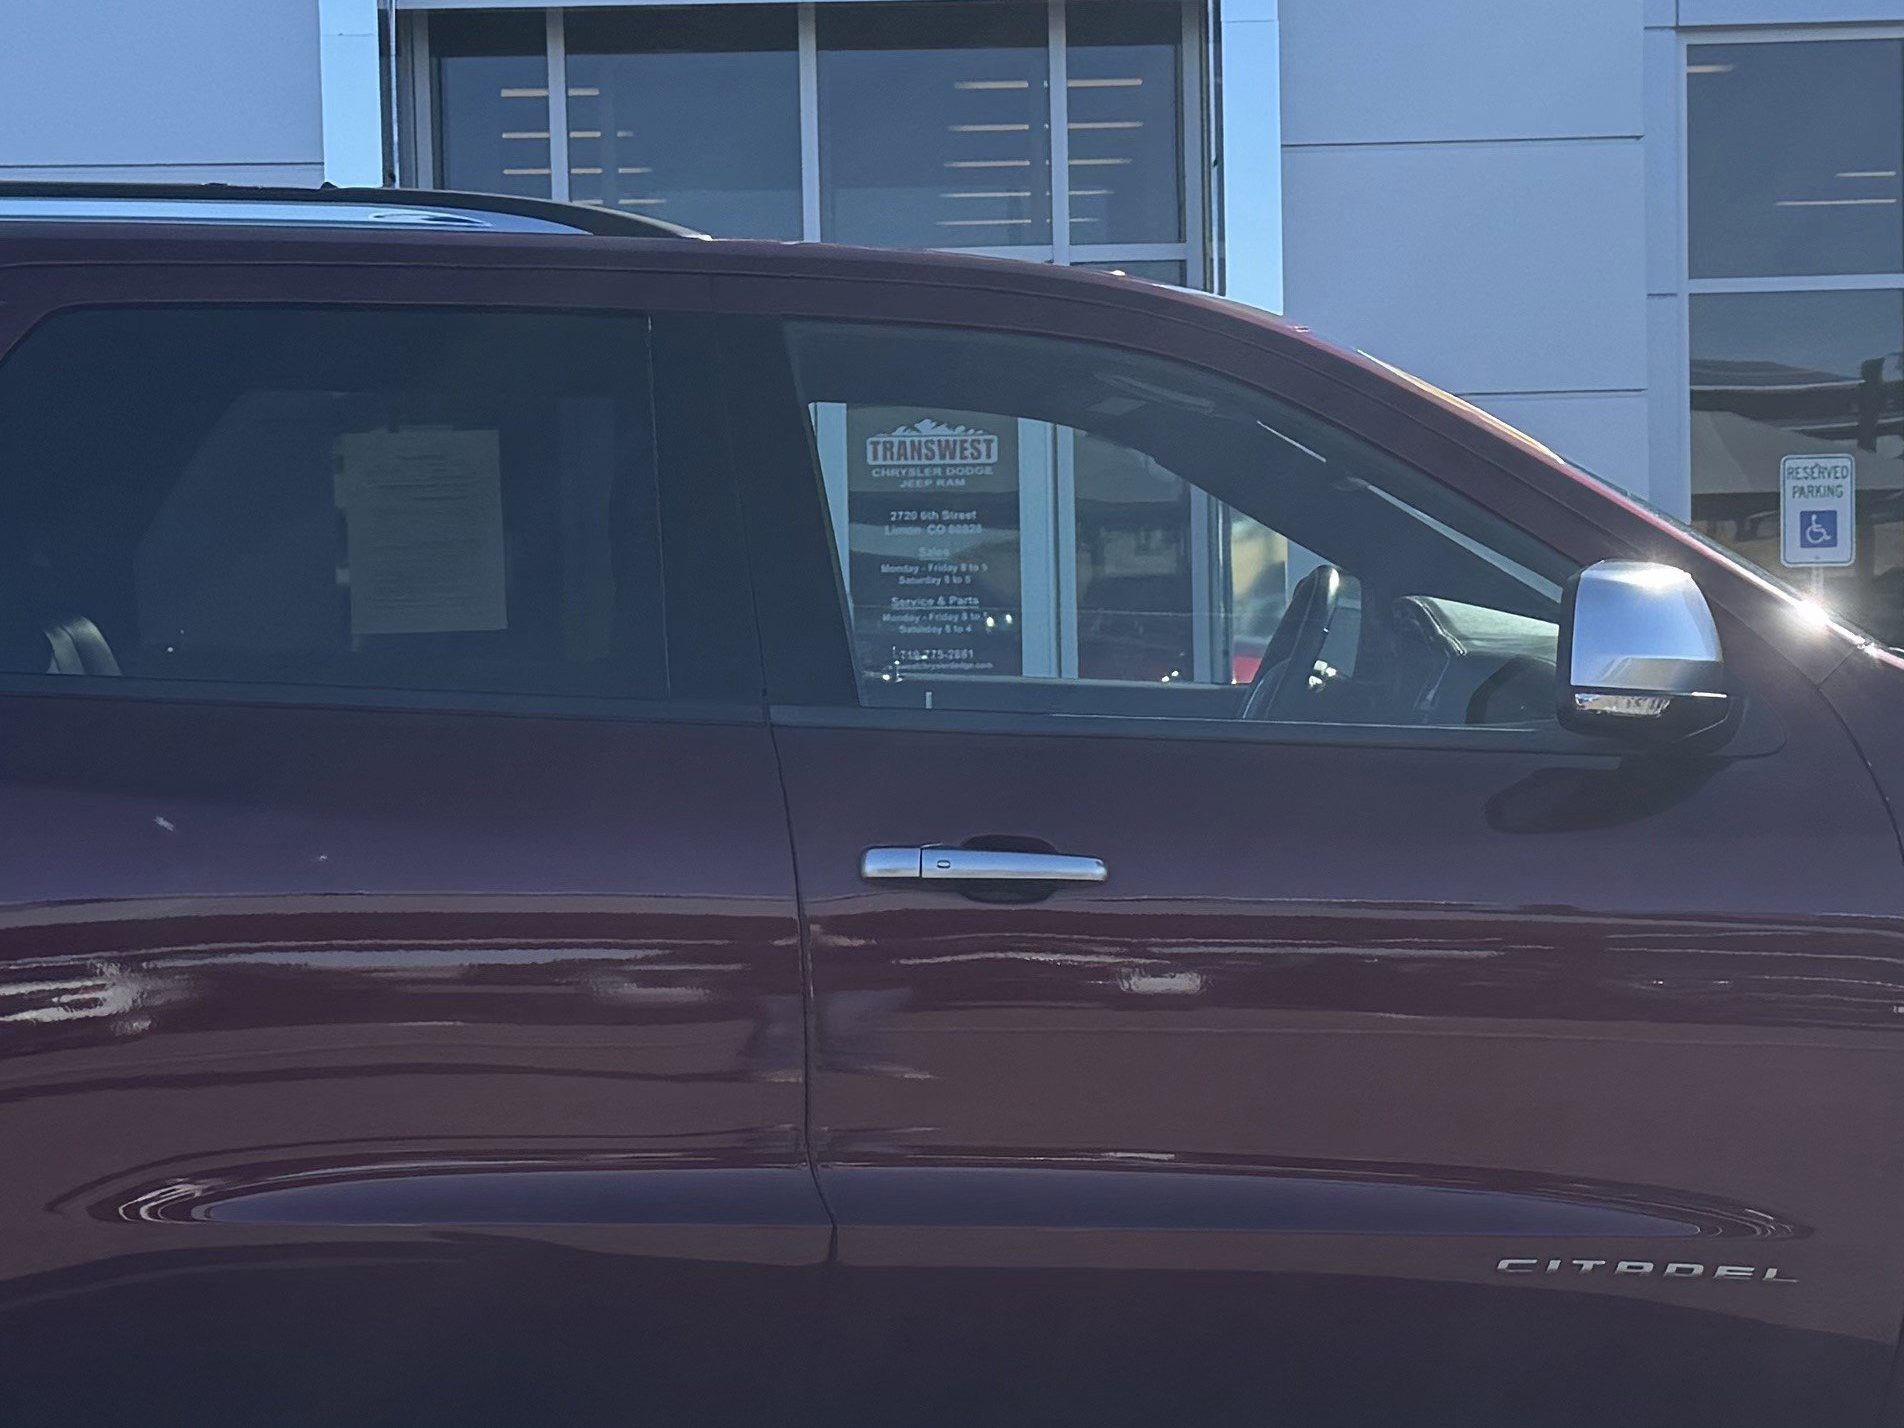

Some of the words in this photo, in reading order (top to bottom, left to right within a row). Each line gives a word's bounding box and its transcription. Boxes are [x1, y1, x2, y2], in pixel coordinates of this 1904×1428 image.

[869, 438, 994, 461] TRANSWEST
[872, 467, 943, 477] CHRYSLER
[946, 466, 993, 476] DODGE
[1786, 465, 1849, 480] RESERVED
[899, 479, 933, 488] JEEP
[936, 478, 966, 487] RAM
[1792, 484, 1844, 499] PARKING
[941, 510, 977, 520] Street
[1497, 1259, 1799, 1282] CITADEL
